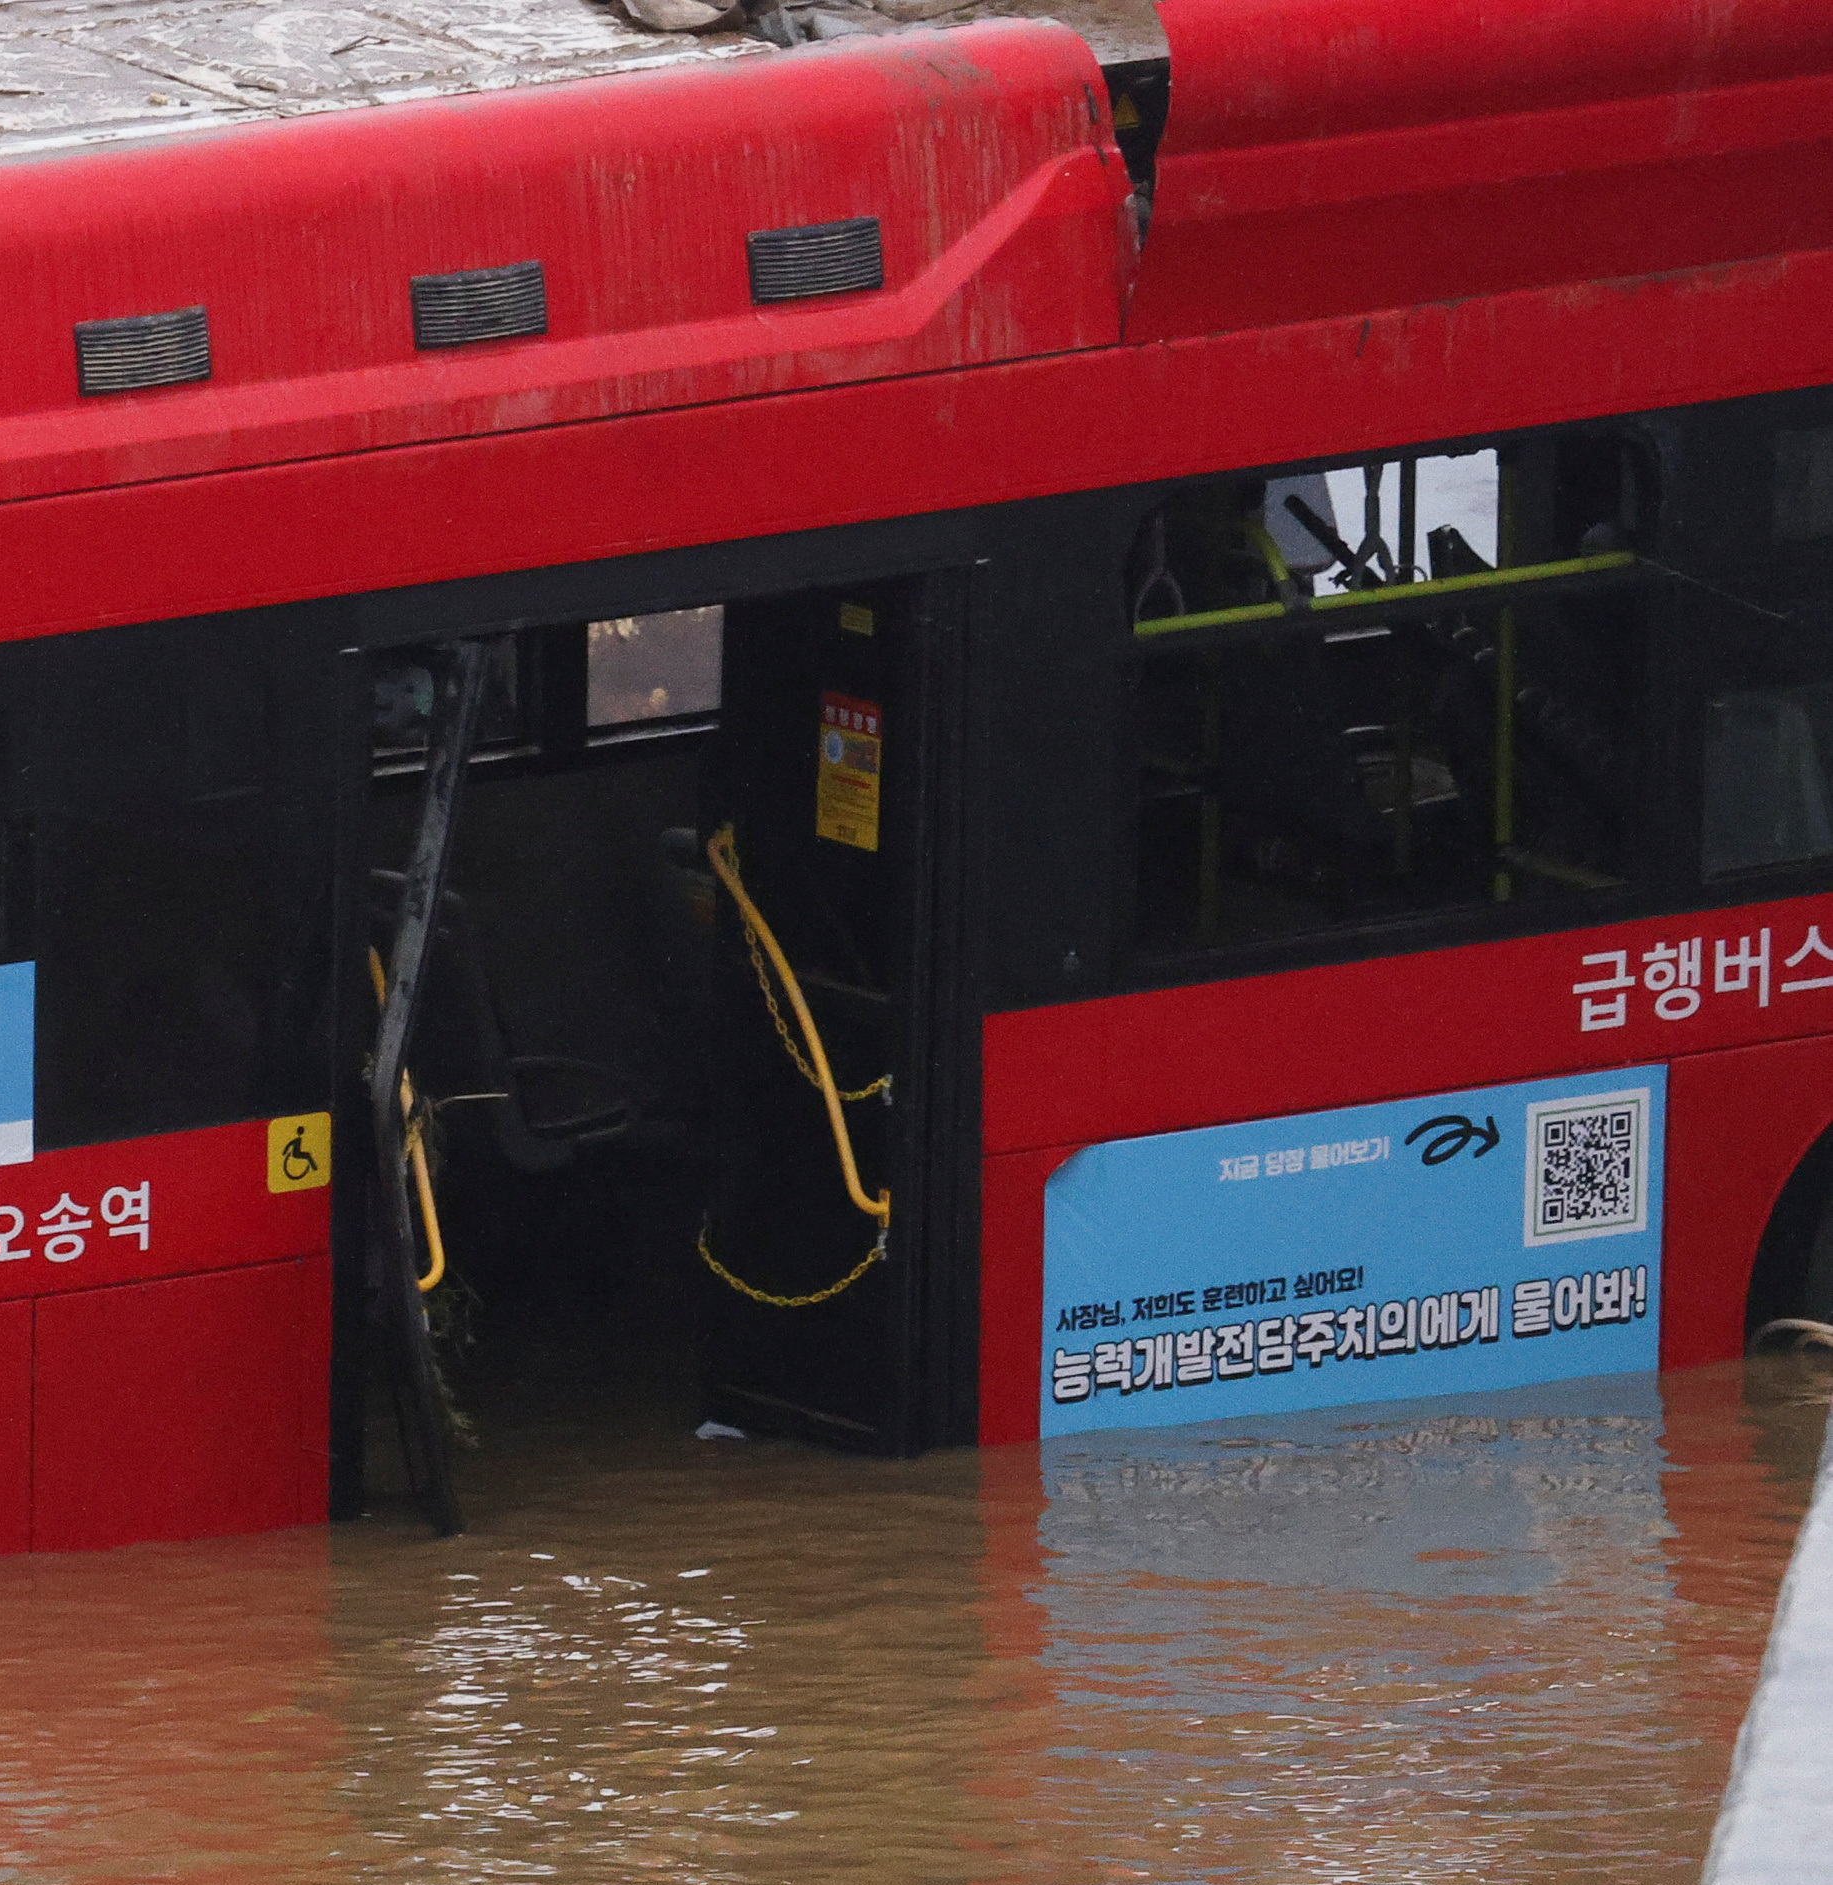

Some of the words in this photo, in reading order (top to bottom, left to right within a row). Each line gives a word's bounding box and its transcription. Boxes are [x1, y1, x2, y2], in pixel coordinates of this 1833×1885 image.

[1572, 925, 1833, 1032] 급행버스
[1218, 1155, 1260, 1182] 지금
[1052, 1286, 1500, 1404] 능력개발전담주치의에게
[1512, 1264, 1648, 1338] 물어봐!
[1055, 1300, 1127, 1332] 사장님,
[1132, 1290, 1196, 1322] 저희도
[1201, 1276, 1287, 1312] 훈련하고
[1292, 1265, 1364, 1300] 싶어요!
